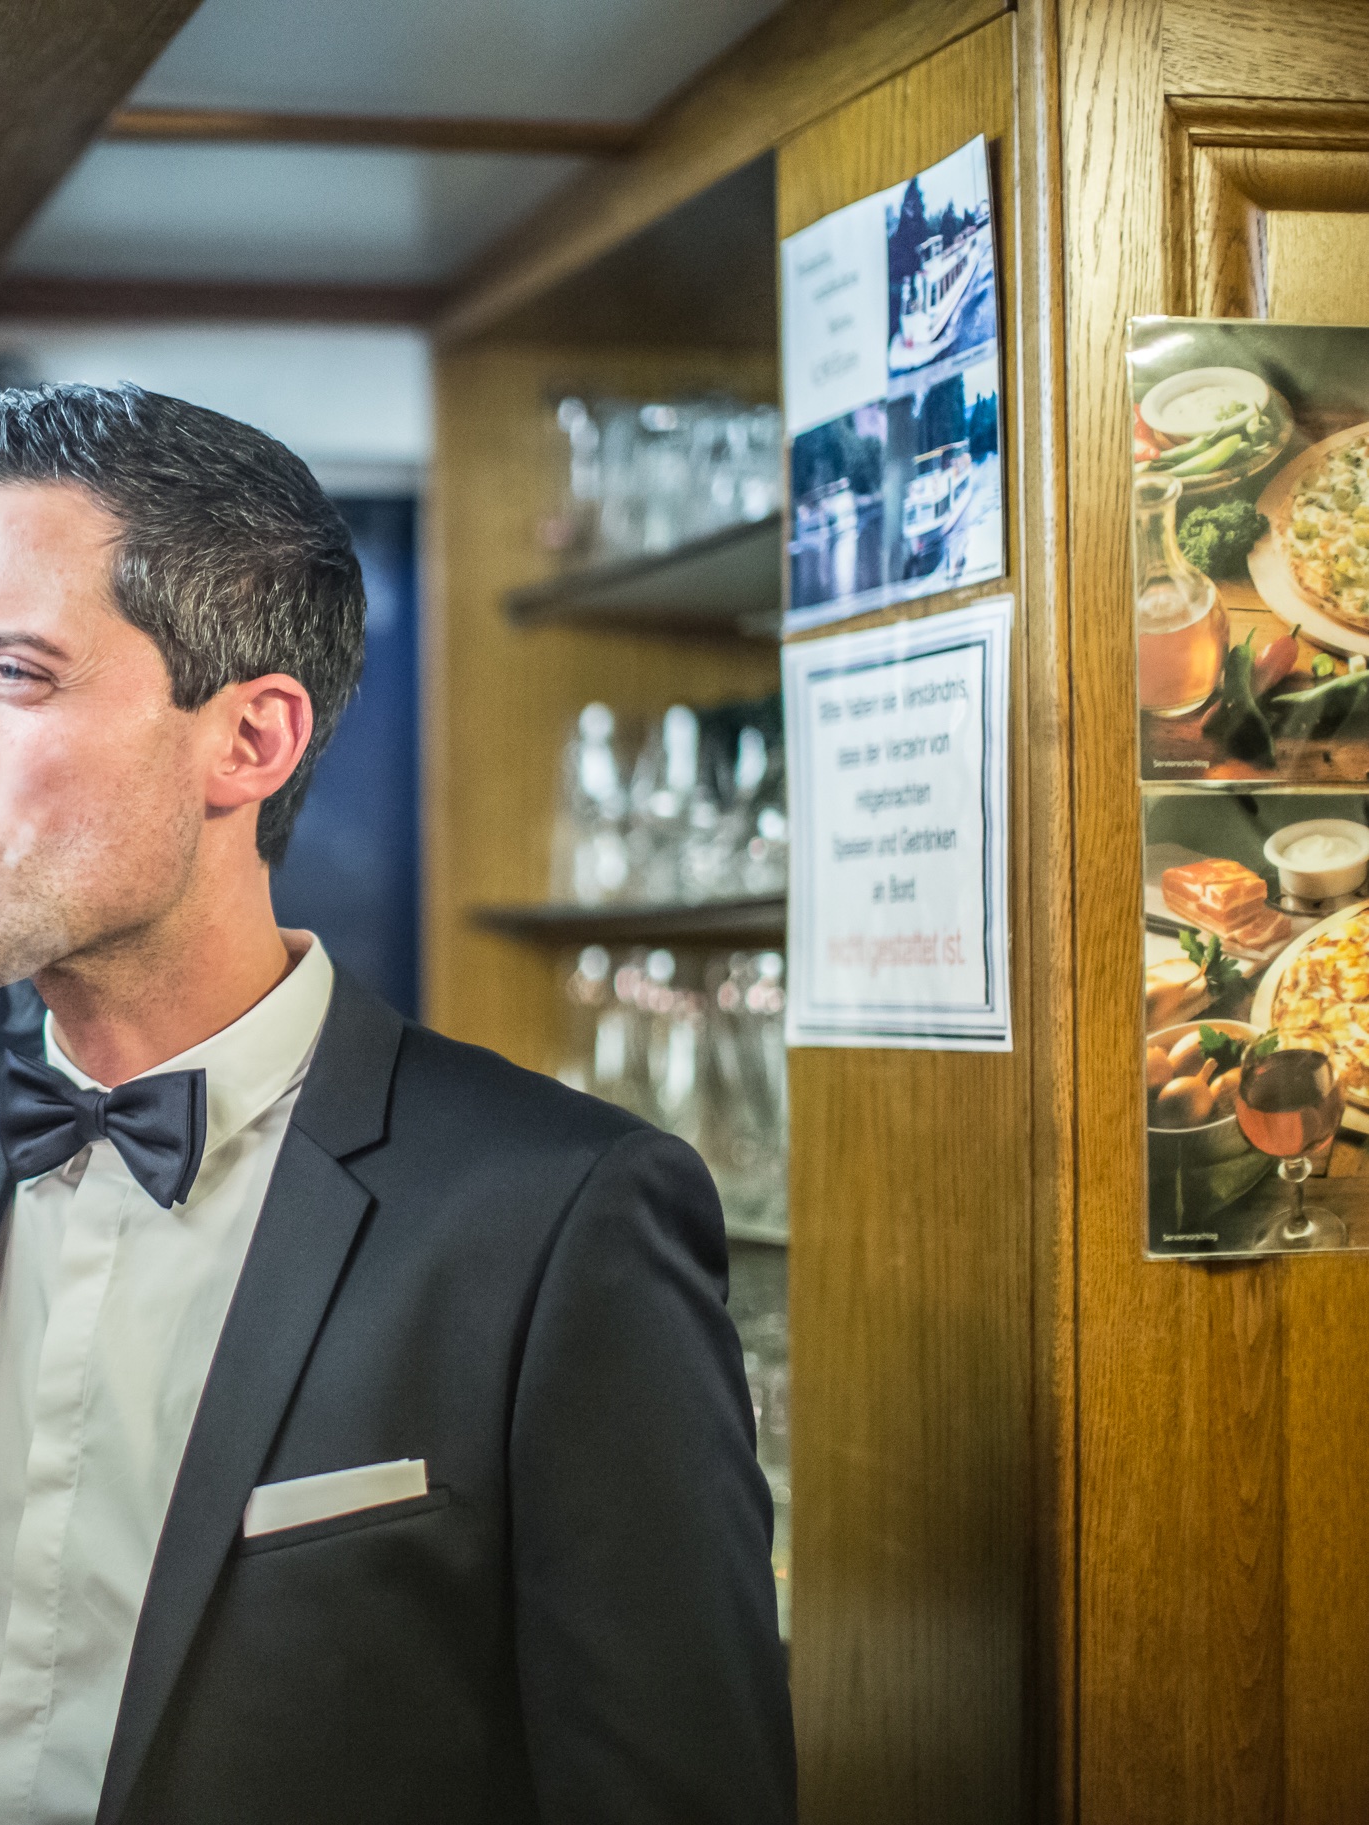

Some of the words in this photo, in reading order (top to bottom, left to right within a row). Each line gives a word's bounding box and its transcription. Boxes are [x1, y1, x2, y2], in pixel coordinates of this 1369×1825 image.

[930, 732, 950, 757] von
[877, 832, 897, 857] und
[900, 825, 957, 854] Getränken
[889, 874, 916, 904] Bord
[869, 928, 938, 978] gestattet
